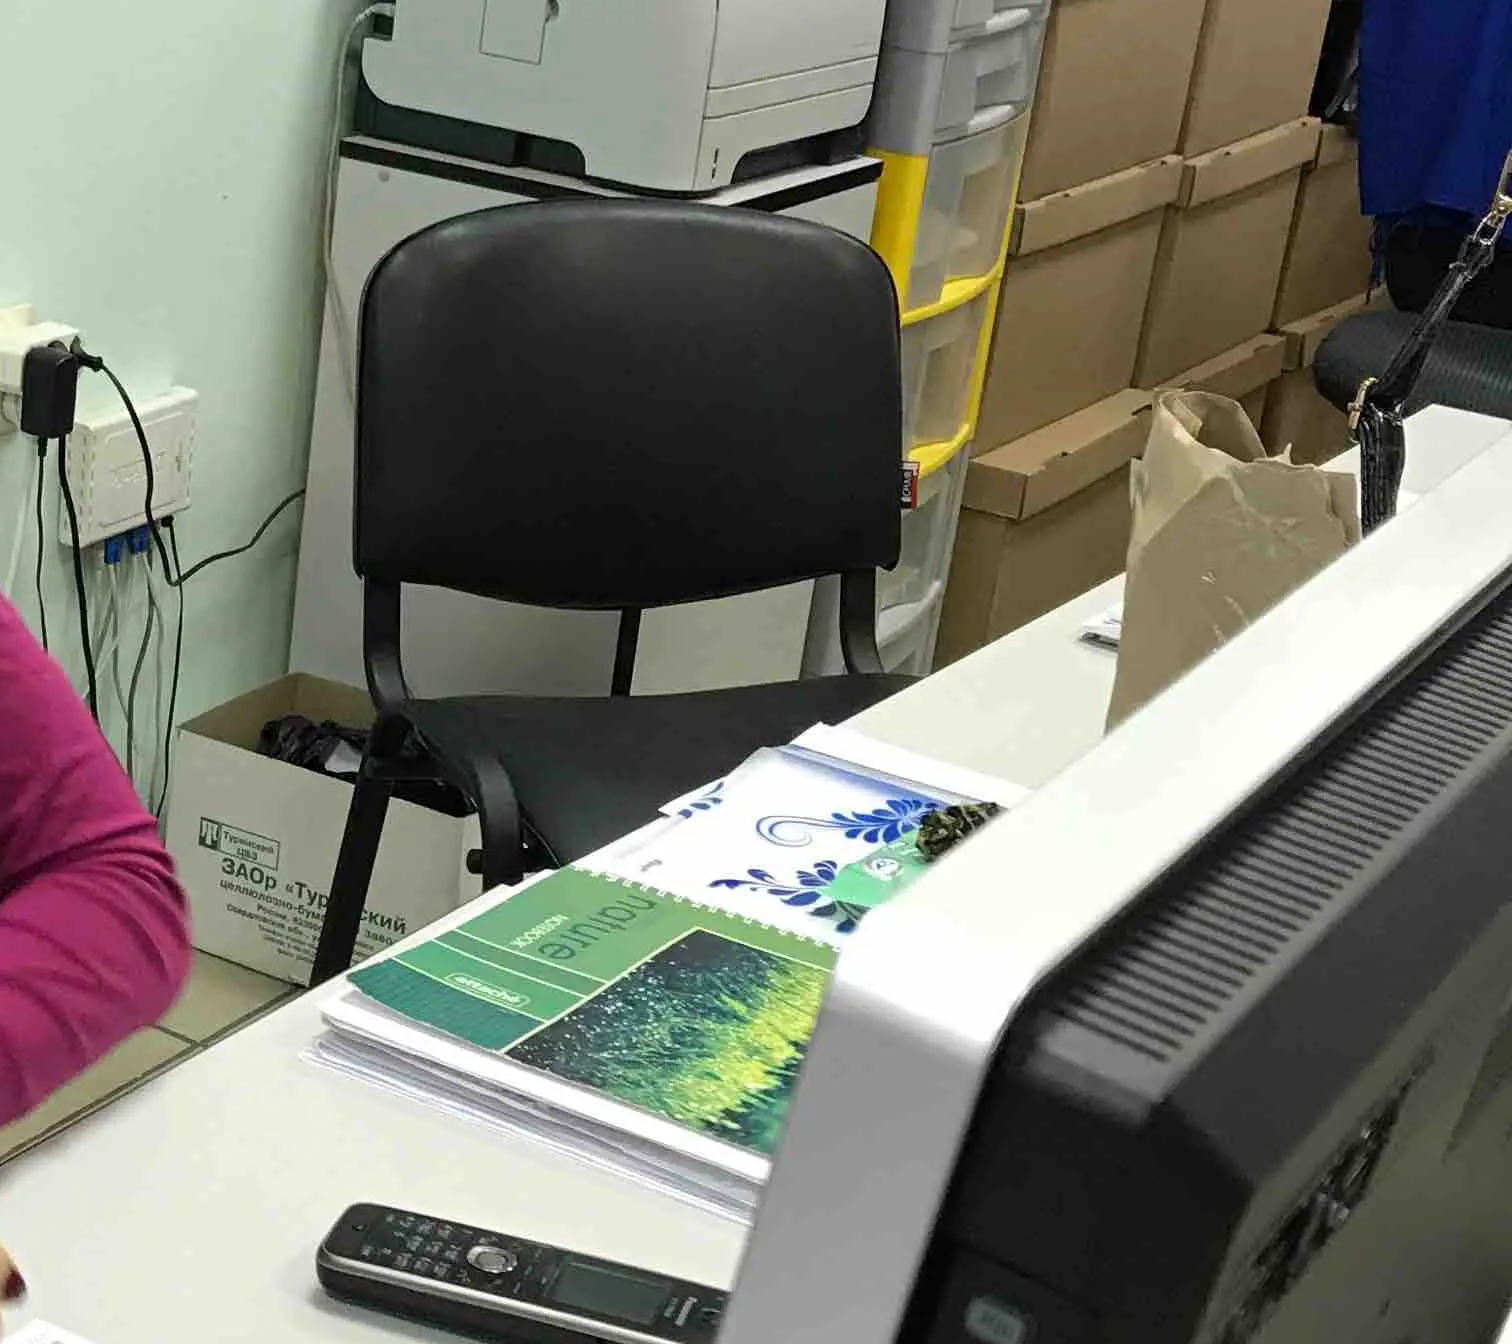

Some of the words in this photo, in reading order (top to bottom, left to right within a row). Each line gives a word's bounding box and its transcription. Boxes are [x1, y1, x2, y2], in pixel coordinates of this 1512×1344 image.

[221, 857, 278, 891] ЗАОр
[510, 914, 569, 949] NOTEBOOK
[538, 892, 658, 960] nature
